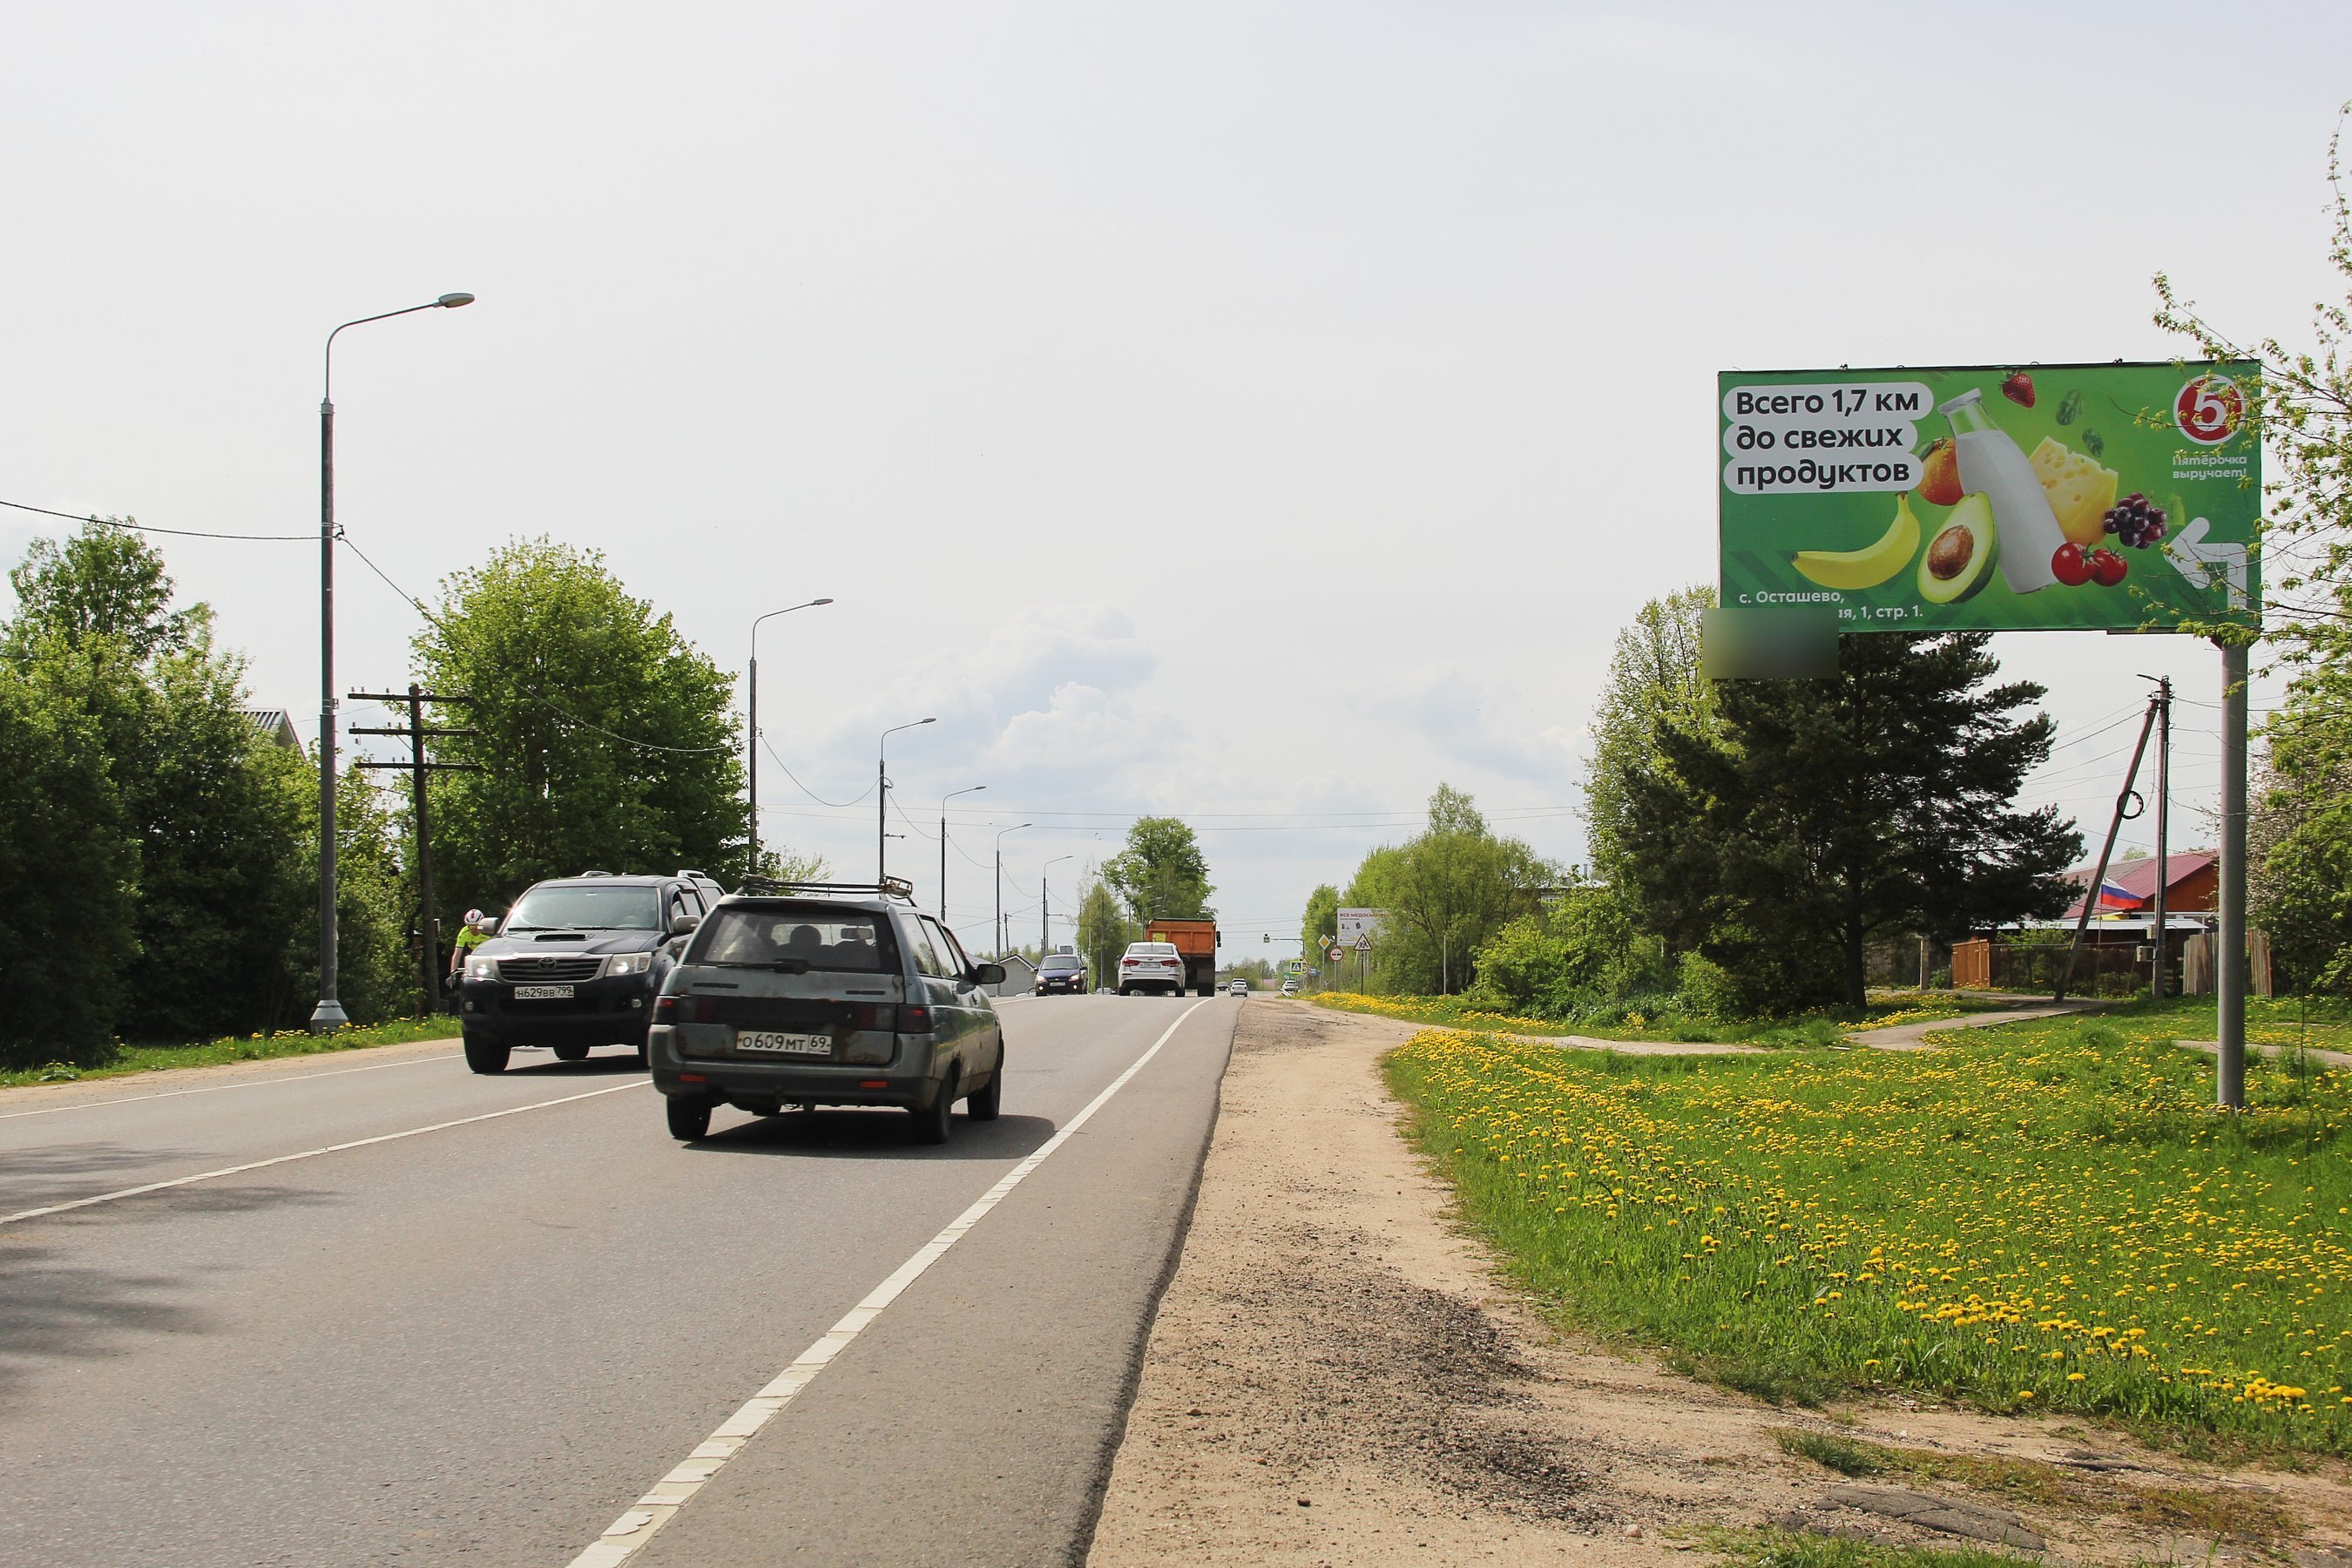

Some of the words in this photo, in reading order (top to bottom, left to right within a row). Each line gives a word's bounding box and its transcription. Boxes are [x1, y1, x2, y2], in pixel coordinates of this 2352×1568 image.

[1737, 392, 1824, 415] Всего
[1832, 389, 1867, 417] 1,7
[1876, 393, 1919, 411] км
[1736, 425, 1775, 449] до
[1784, 429, 1903, 449] свежих
[1737, 459, 1909, 490] продуктов
[2173, 468, 2247, 480] выручает!
[1739, 593, 1751, 604] с.
[1756, 591, 1844, 604] Осташево,
[1861, 606, 1871, 620] 1,
[1876, 607, 1908, 620] стр.
[1912, 605, 1923, 618] 1.
[810, 1036, 827, 1048] 69
